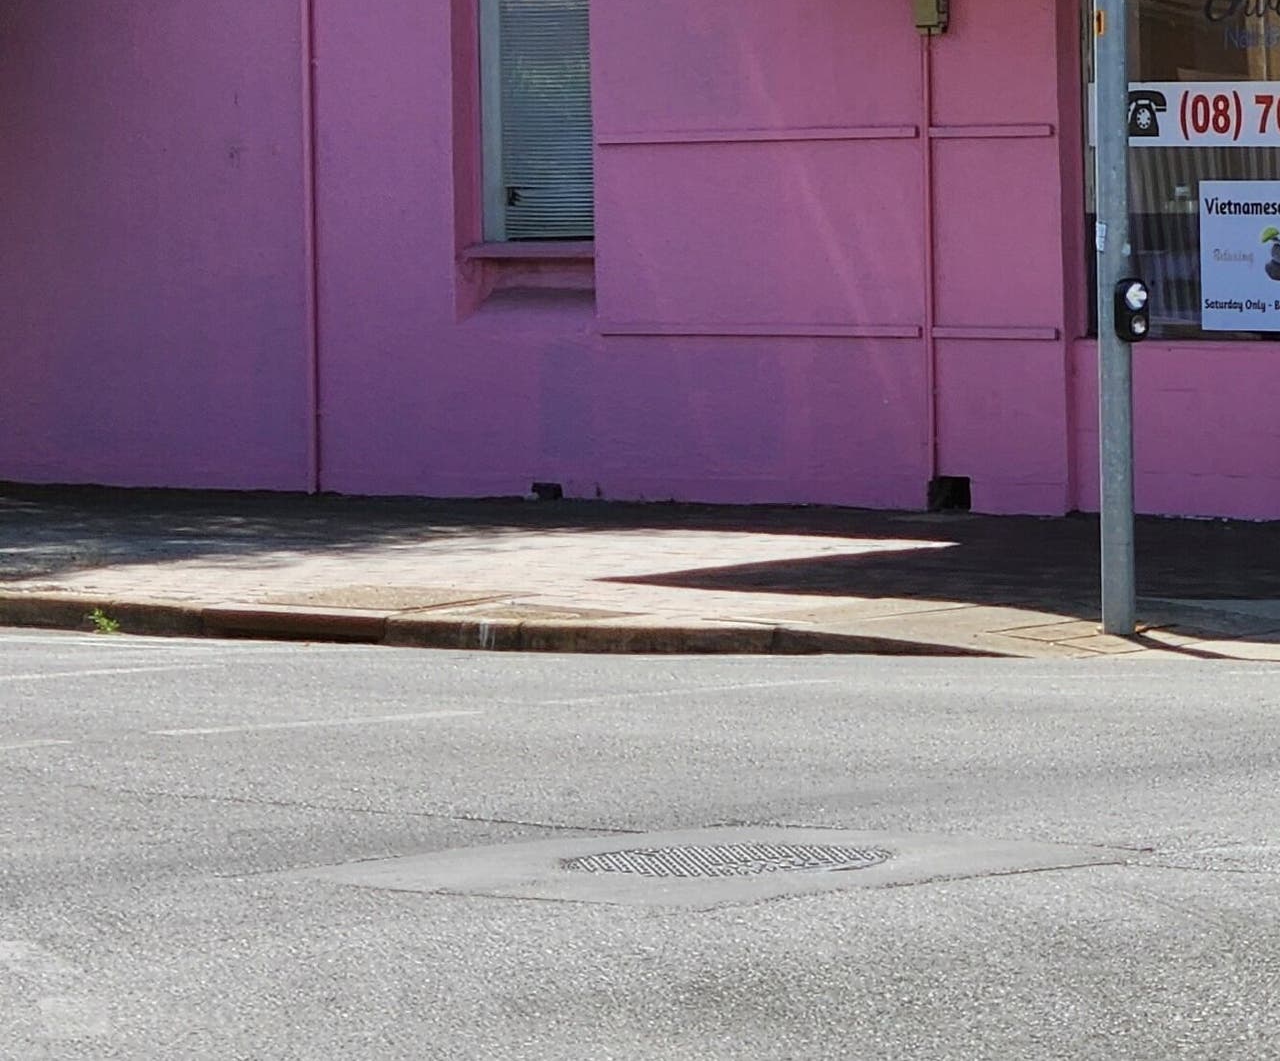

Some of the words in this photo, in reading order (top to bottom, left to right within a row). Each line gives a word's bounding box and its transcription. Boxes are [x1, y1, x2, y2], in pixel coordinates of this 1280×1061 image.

[1180, 90, 1242, 140] (08)
[1205, 298, 1243, 313] Saturday
[1245, 299, 1266, 314] Only
